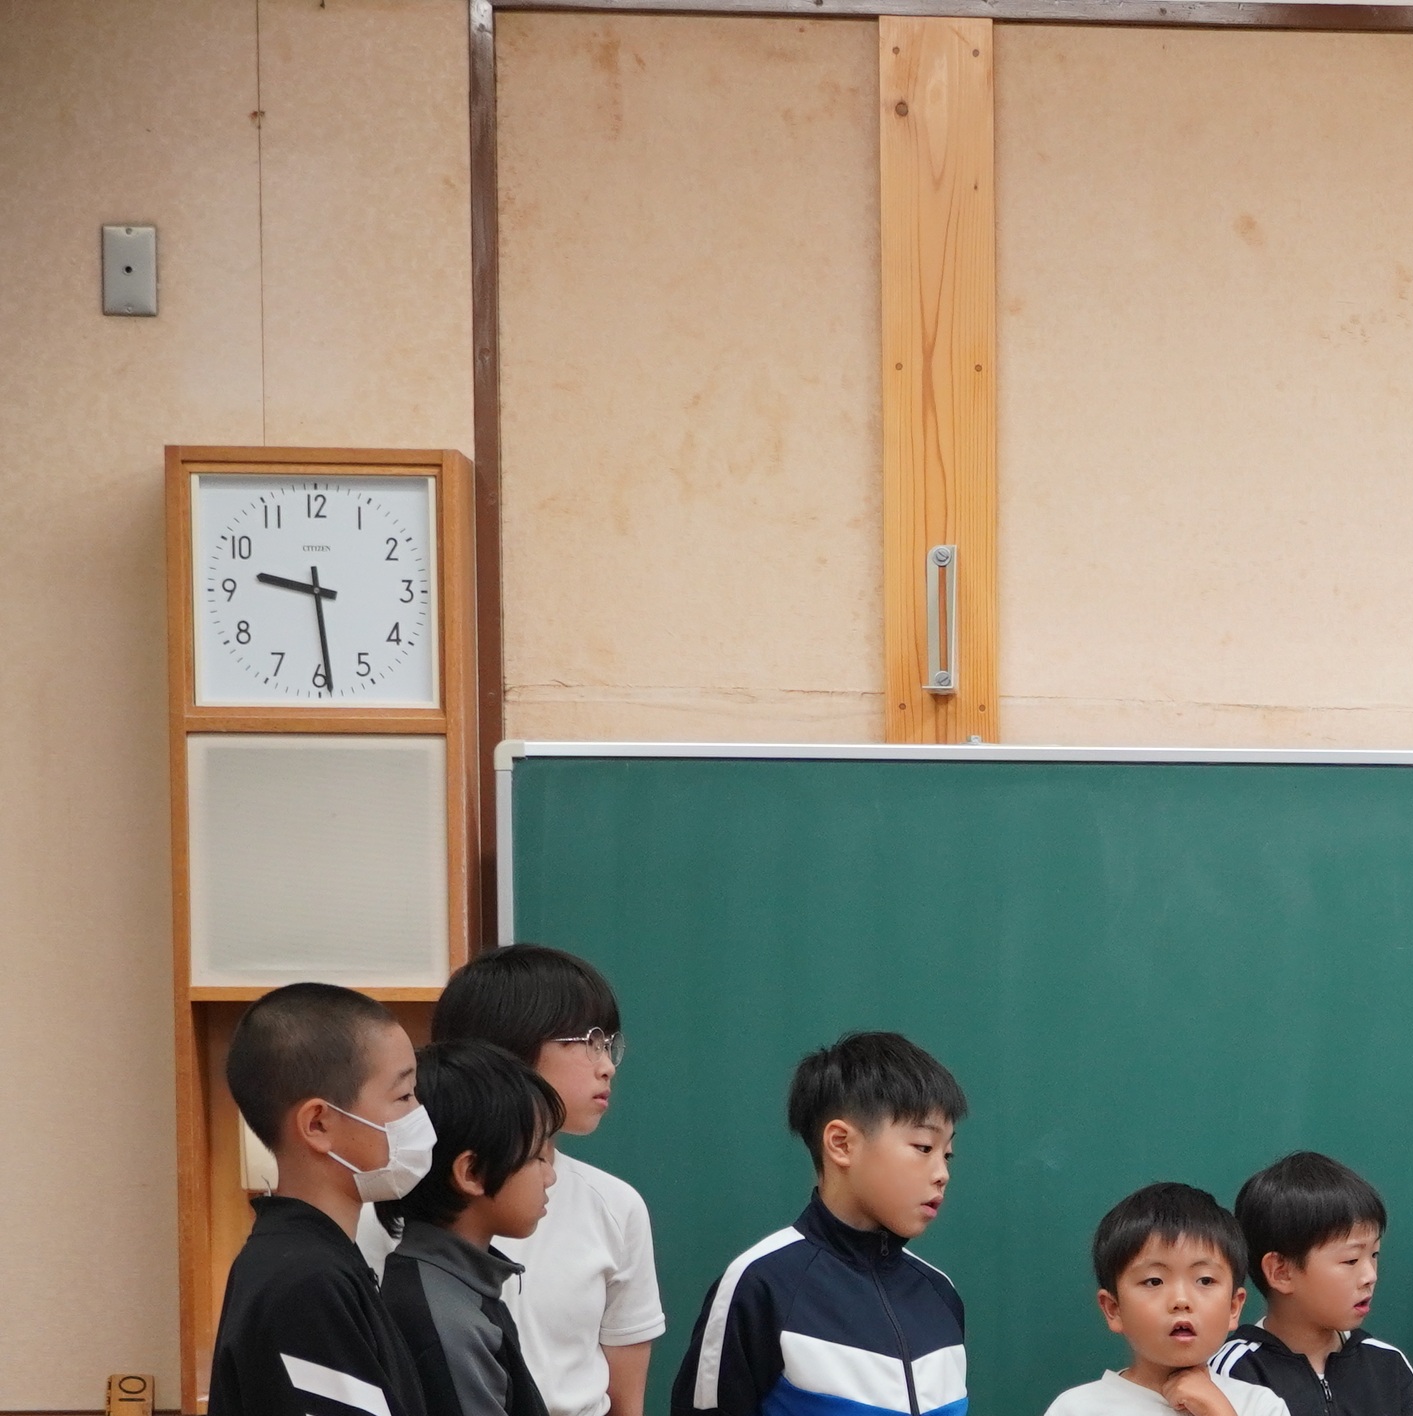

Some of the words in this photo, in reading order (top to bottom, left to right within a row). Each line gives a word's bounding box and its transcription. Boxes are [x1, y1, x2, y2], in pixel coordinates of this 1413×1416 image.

[264, 505, 281, 529] 11
[306, 494, 327, 518] 12
[232, 535, 252, 560] 10
[302, 544, 331, 552] CITIZEN
[385, 537, 399, 561] 2
[222, 578, 237, 601] 9
[399, 579, 414, 603] 3
[236, 620, 251, 645] 8
[386, 622, 402, 646] 4
[270, 652, 285, 676] 7
[312, 664, 328, 688] 6
[356, 652, 371, 676] 5
[118, 1375, 147, 1402] 10
